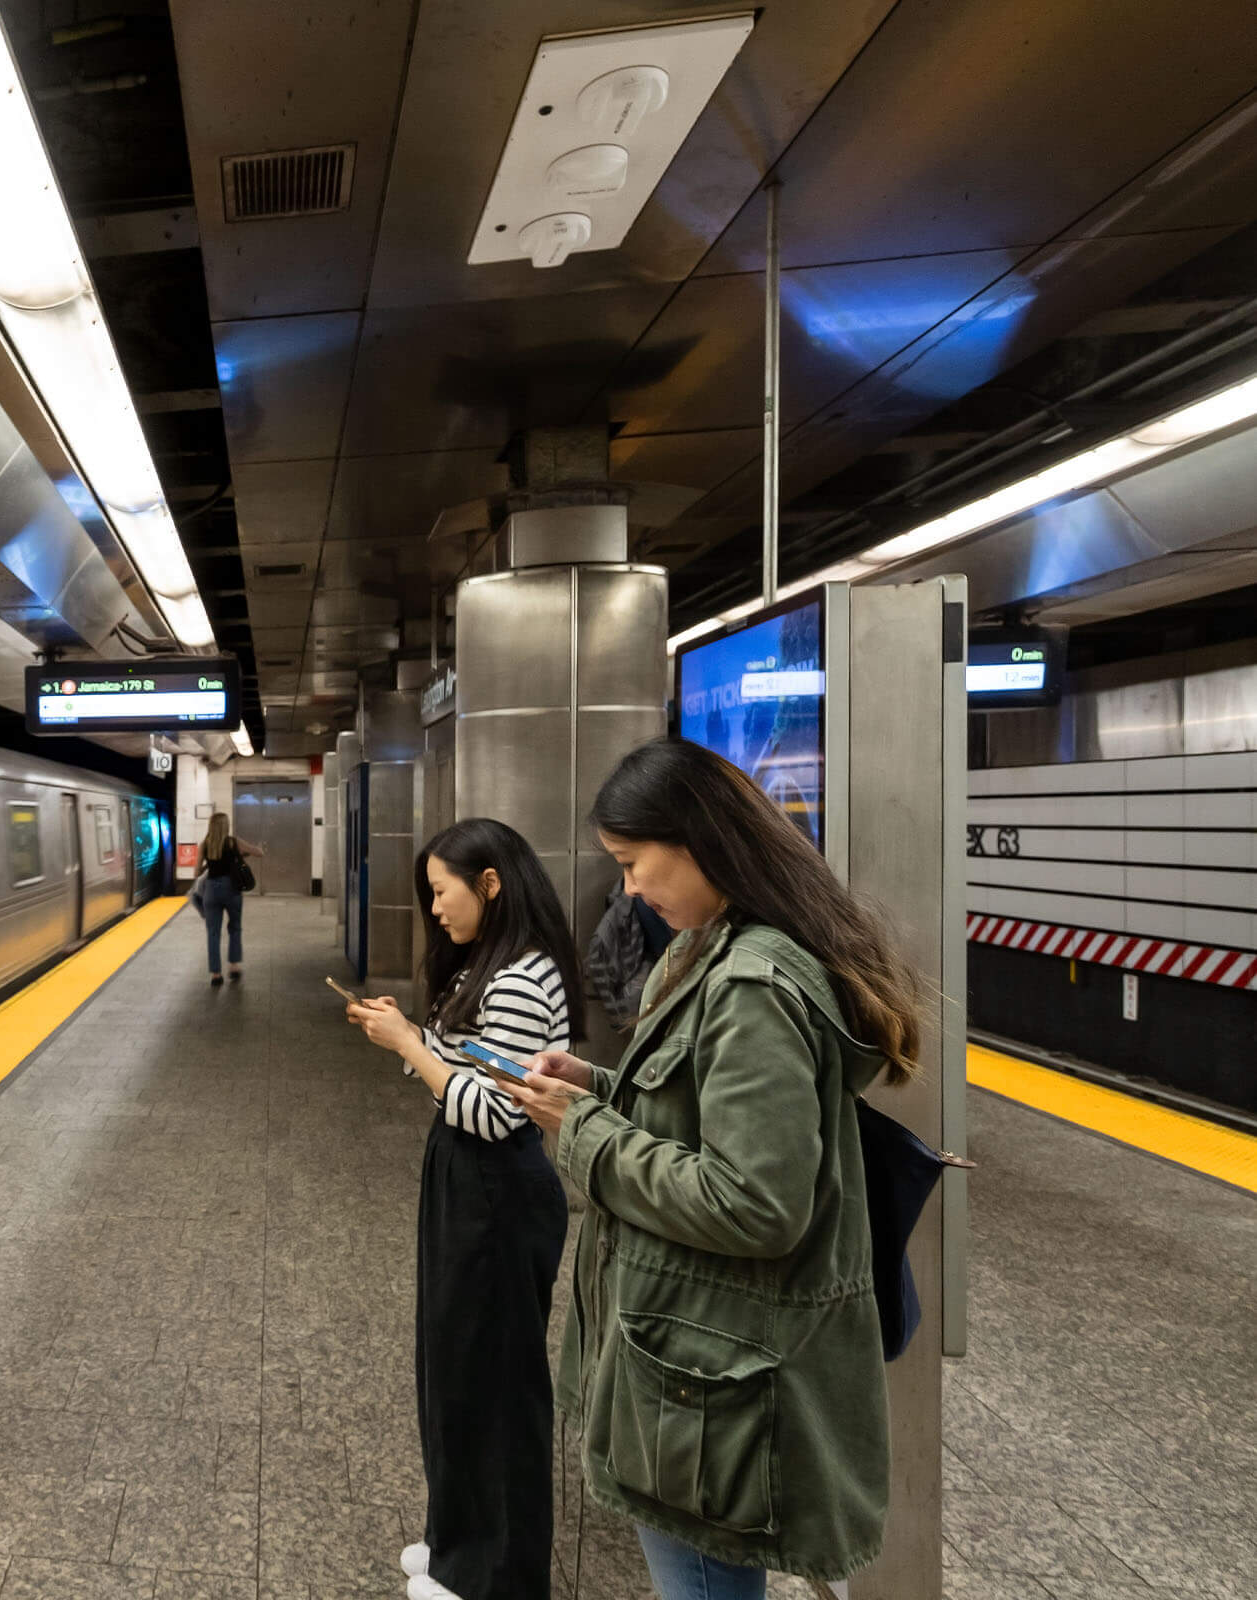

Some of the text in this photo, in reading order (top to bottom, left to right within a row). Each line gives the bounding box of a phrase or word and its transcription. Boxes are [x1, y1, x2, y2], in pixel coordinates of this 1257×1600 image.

[1011, 647, 1044, 661] 0 min
[156, 756, 170, 769] 10
[998, 825, 1020, 857] 63
